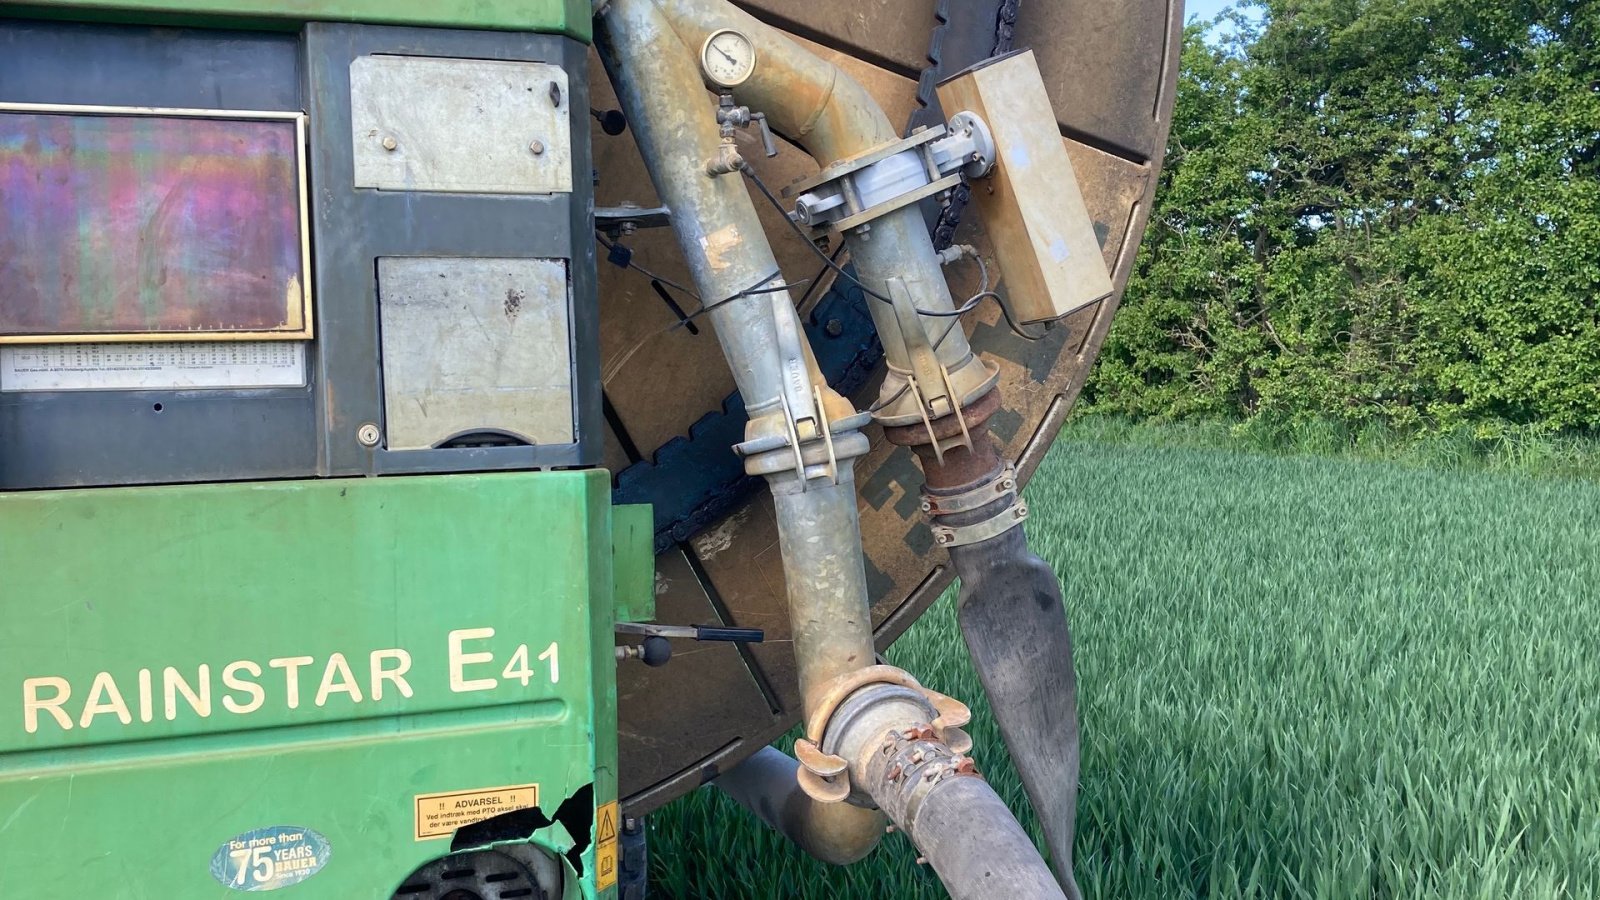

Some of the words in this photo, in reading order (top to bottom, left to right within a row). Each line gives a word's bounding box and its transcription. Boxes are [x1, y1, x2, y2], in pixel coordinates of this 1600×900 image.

[23, 648, 414, 733] RAINSTAR
[448, 627, 560, 693] E41
[455, 796, 503, 809] ADVARSEL
[440, 811, 465, 819] indtræk
[229, 840, 246, 850] For
[249, 836, 276, 847] more
[278, 832, 303, 843] than
[229, 846, 274, 885] 75
[273, 845, 313, 861] YEARS
[275, 857, 317, 872] BAUER
